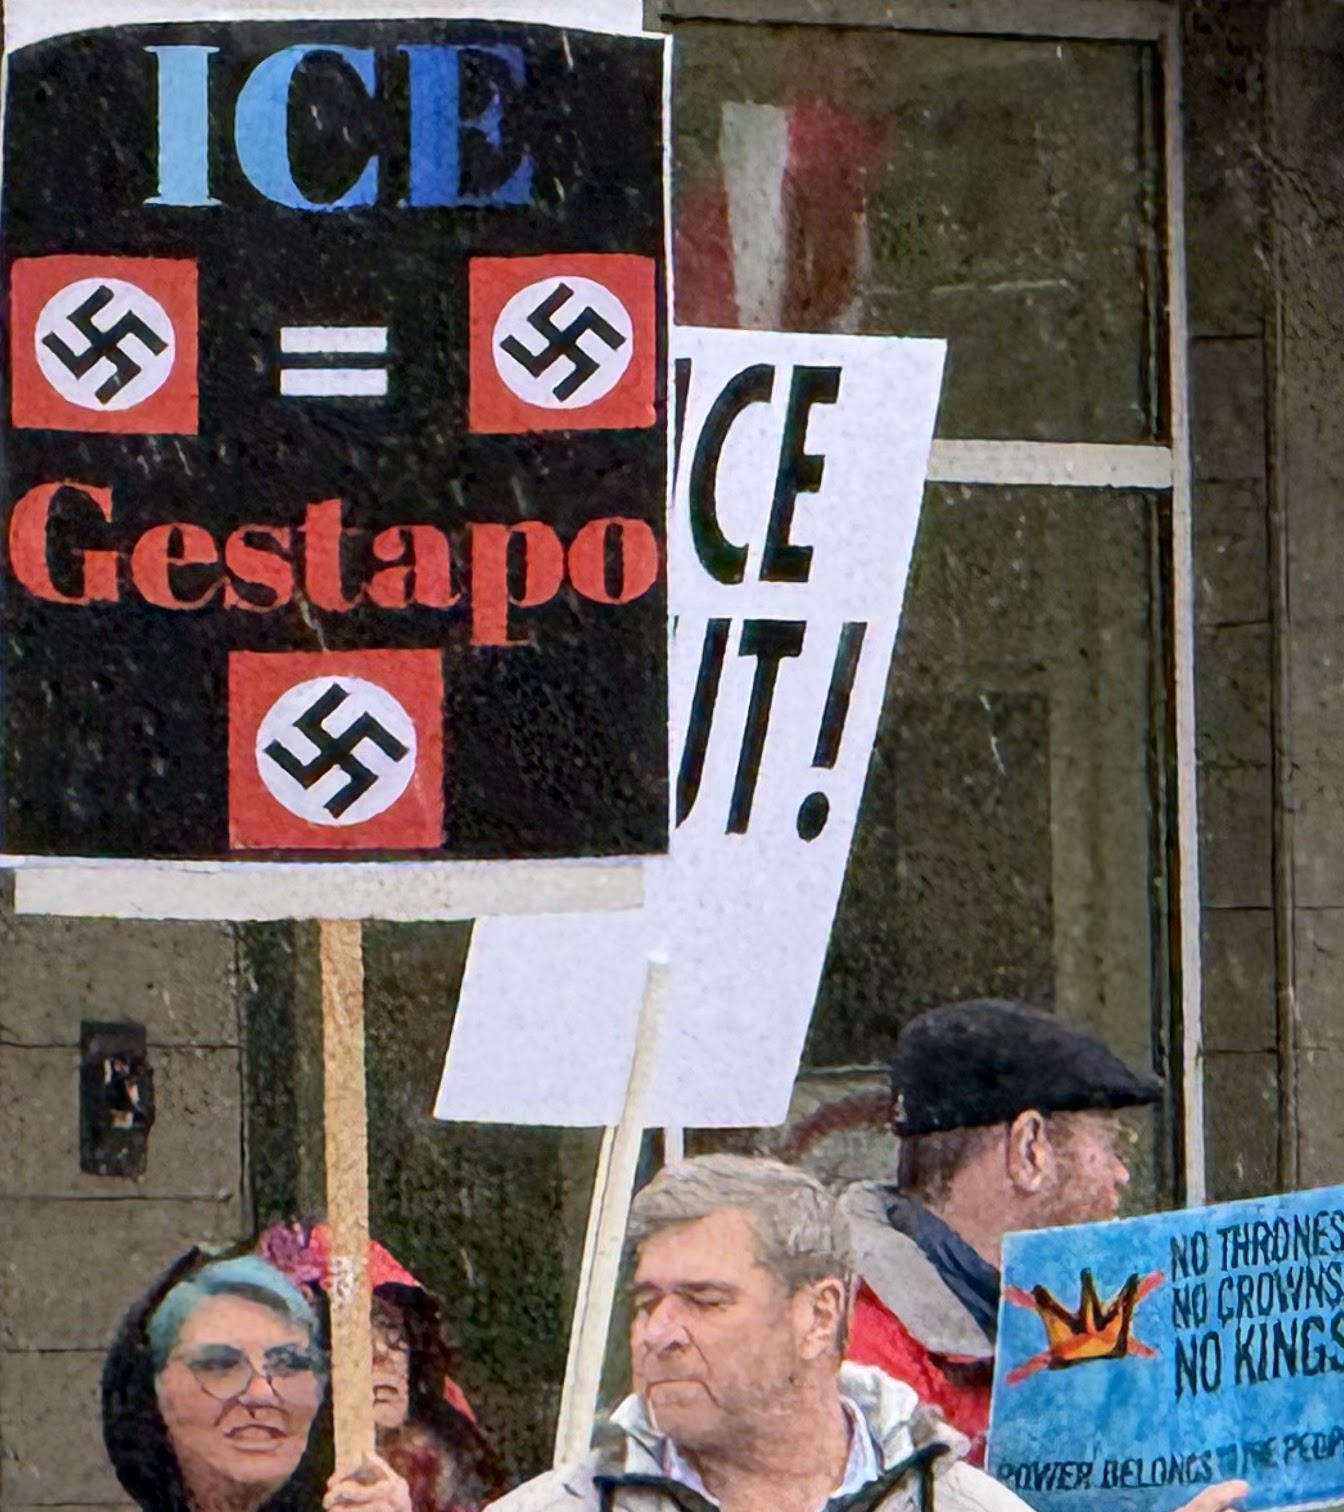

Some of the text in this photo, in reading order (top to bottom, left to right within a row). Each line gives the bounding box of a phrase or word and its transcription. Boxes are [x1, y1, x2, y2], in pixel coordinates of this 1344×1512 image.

[143, 43, 533, 212] ICE
[672, 358, 842, 585] CE
[9, 478, 658, 646] Gestapo
[1170, 1231, 1210, 1282] NO
[1171, 1281, 1207, 1330] NO
[1175, 1330, 1223, 1400] NO
[1100, 1450, 1213, 1489] BELONGS
